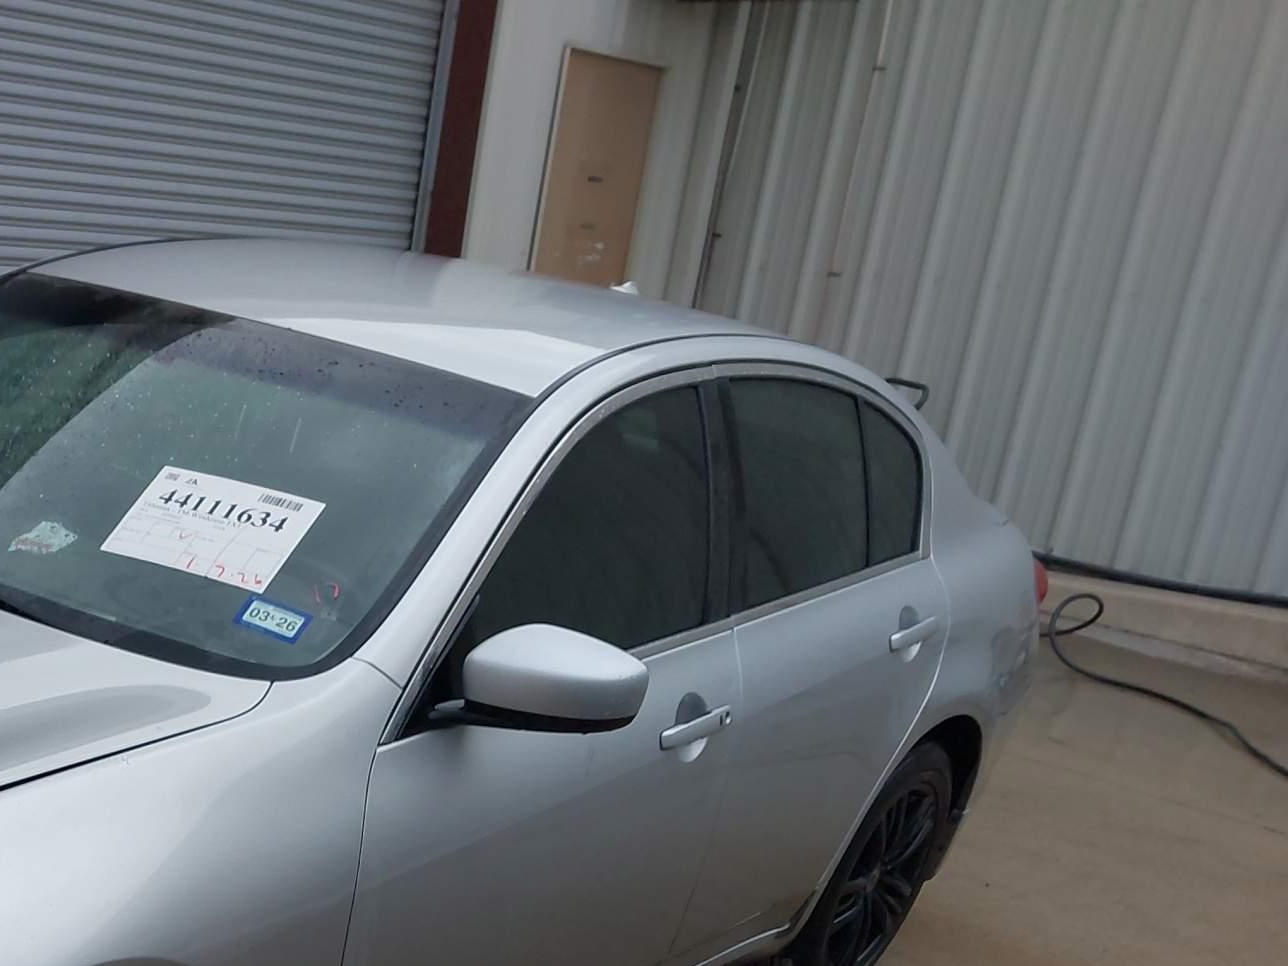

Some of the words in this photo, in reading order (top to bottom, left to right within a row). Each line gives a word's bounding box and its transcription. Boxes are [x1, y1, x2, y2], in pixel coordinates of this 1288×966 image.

[159, 488, 289, 533] 44111634
[249, 607, 271, 622] 03
[275, 617, 298, 632] 26
